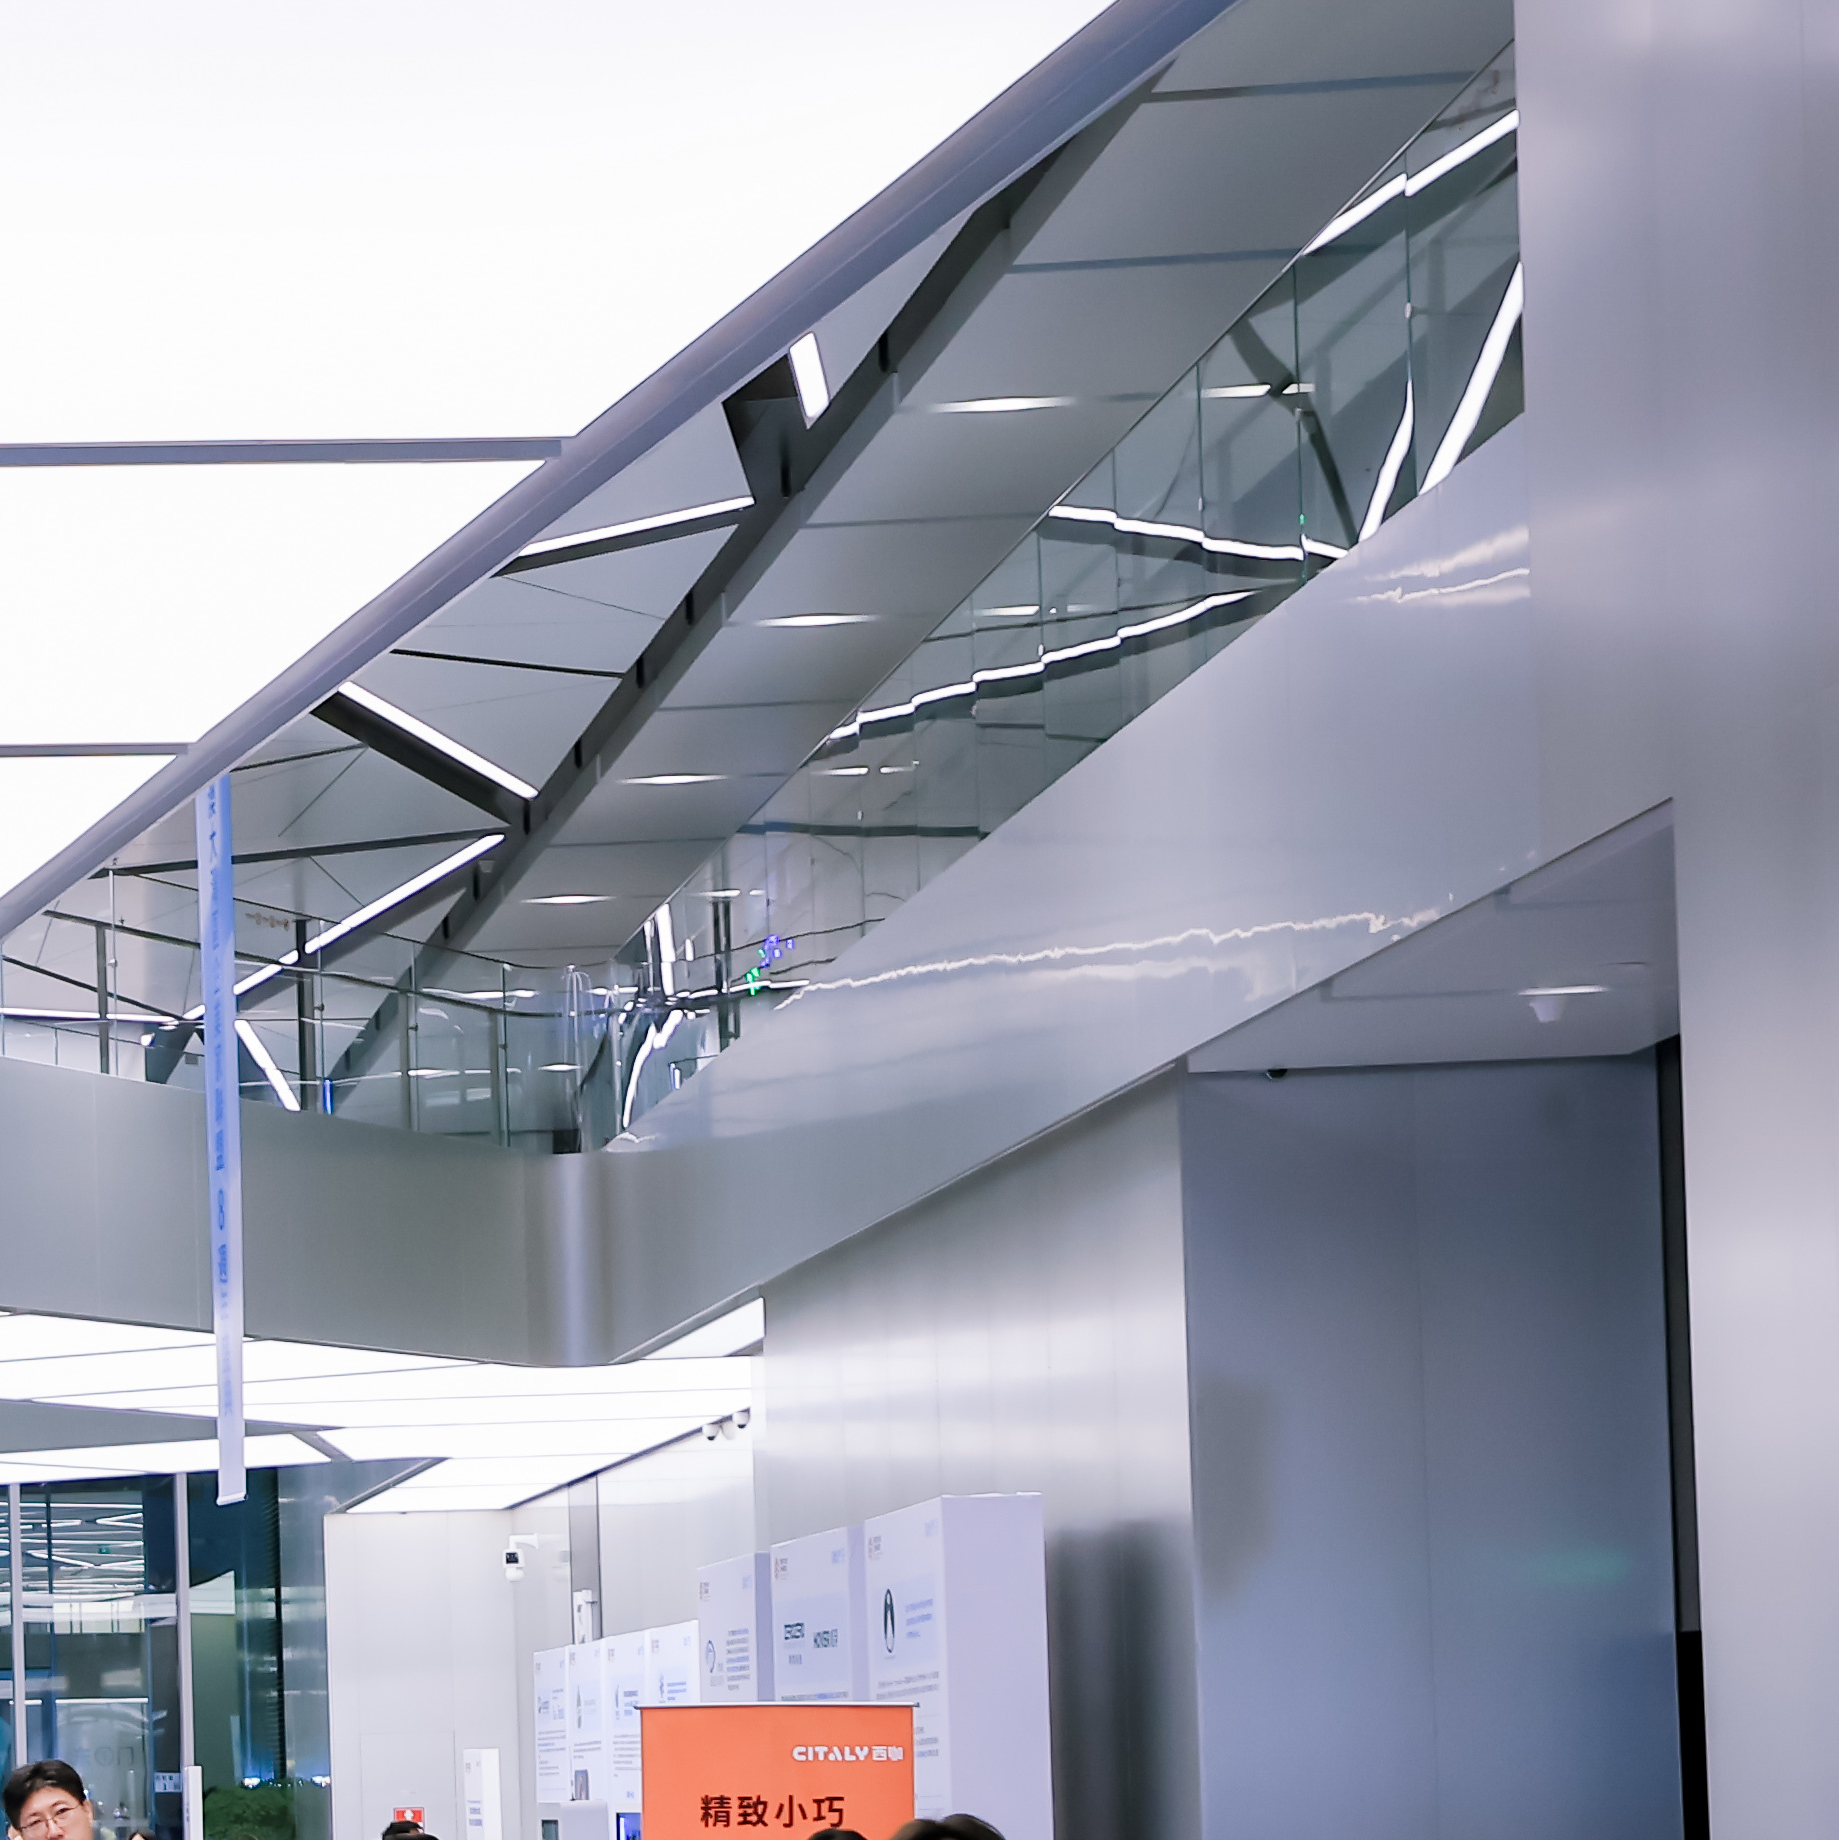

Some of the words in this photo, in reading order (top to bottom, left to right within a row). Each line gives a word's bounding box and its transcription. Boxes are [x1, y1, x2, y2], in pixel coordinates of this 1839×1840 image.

[792, 1745, 869, 1761] CITALY
[700, 1794, 845, 1828] 精致小巧
